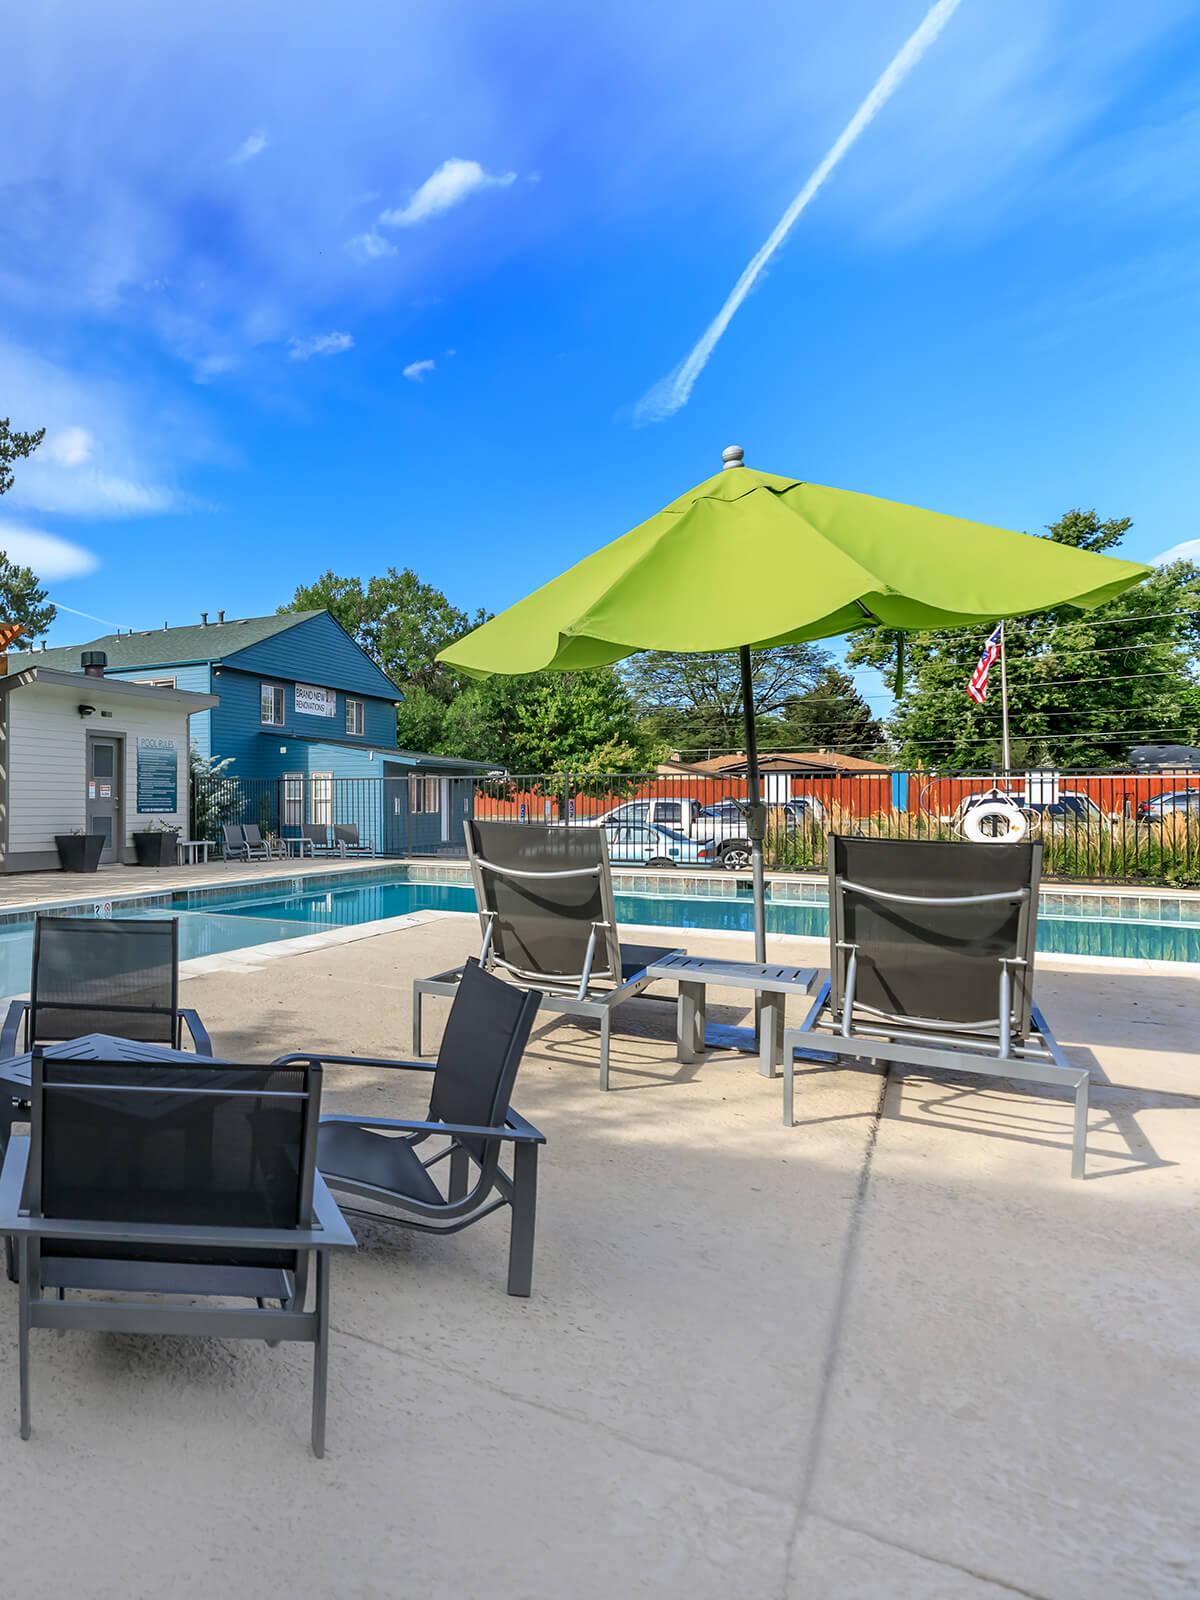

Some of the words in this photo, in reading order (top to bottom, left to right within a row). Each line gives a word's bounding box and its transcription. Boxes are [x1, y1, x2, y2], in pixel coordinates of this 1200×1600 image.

[296, 687, 313, 700] BRAND
[313, 690, 325, 702] NEW
[141, 737, 157, 748] POOL
[158, 738, 175, 749] RULES
